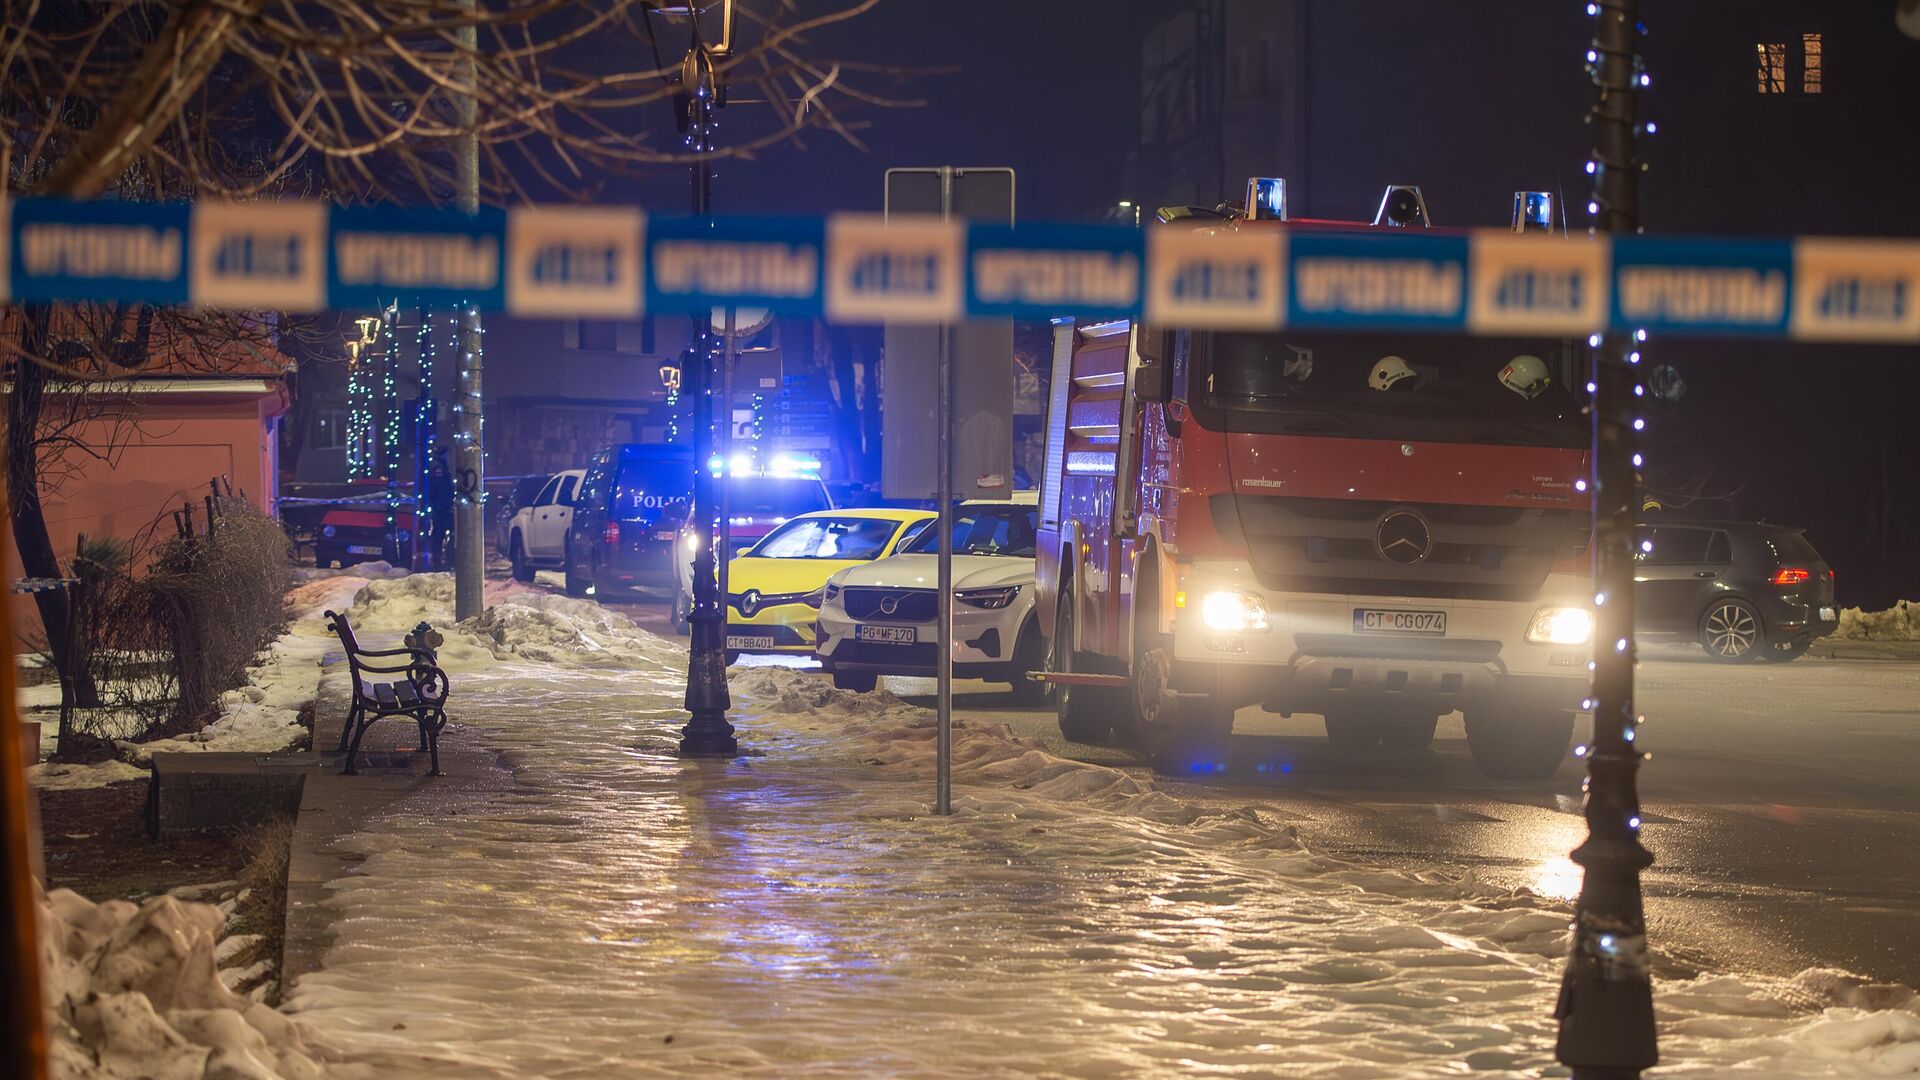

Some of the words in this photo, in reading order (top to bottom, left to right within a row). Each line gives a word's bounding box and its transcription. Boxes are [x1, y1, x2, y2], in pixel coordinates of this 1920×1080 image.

[1242, 475, 1282, 488] rosenbauer
[1365, 612, 1385, 628] CT
[1394, 613, 1443, 631] CG074
[862, 627, 876, 639] PG
[727, 637, 739, 648] CT
